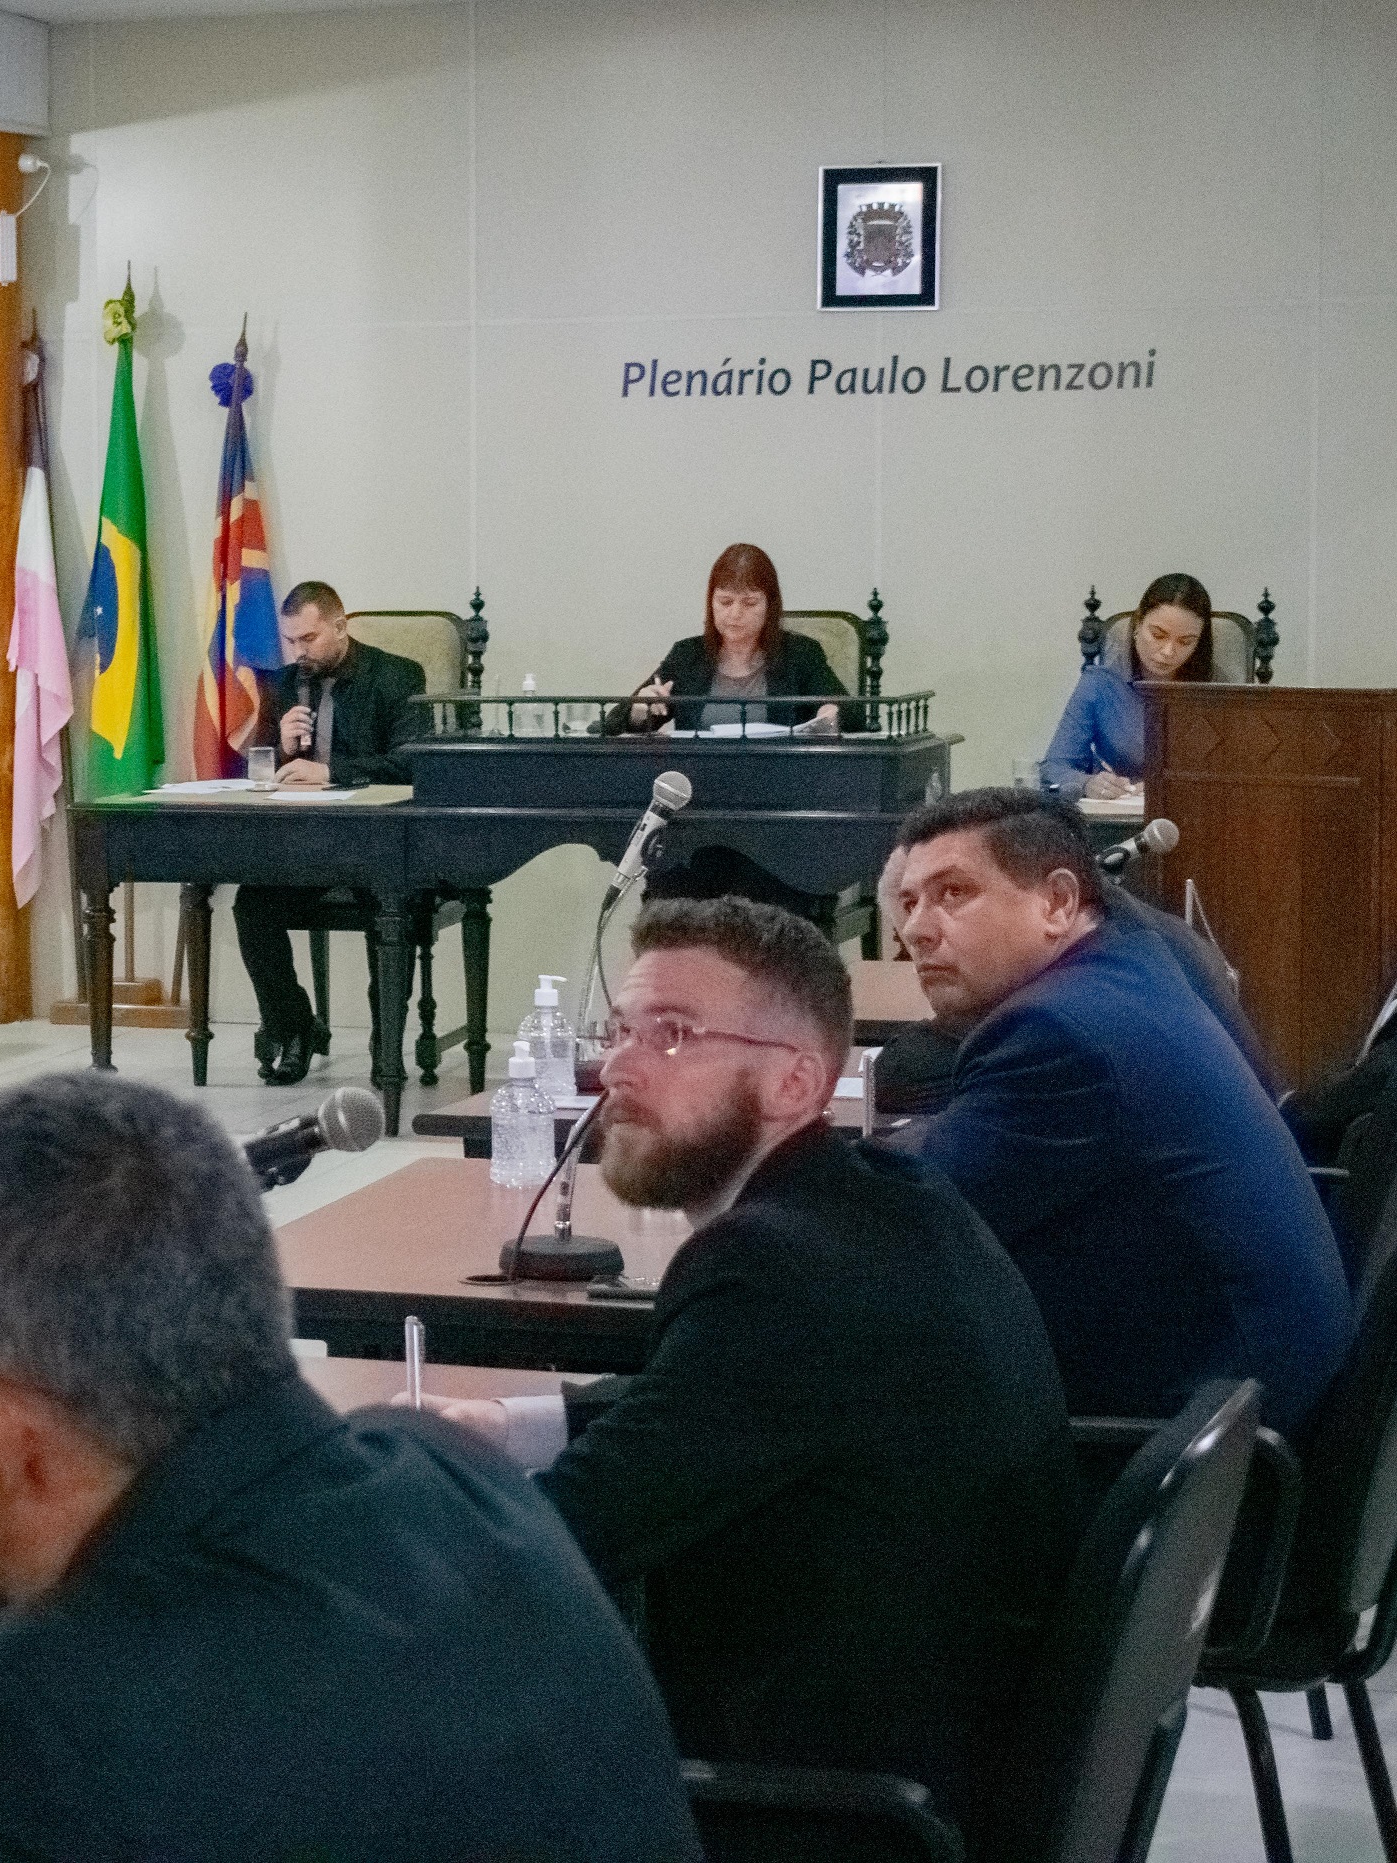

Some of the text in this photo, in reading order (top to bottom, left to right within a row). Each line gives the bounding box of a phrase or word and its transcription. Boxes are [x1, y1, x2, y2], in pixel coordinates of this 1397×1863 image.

[621, 348, 1157, 398] Plenário Paulo Lorenzoni
